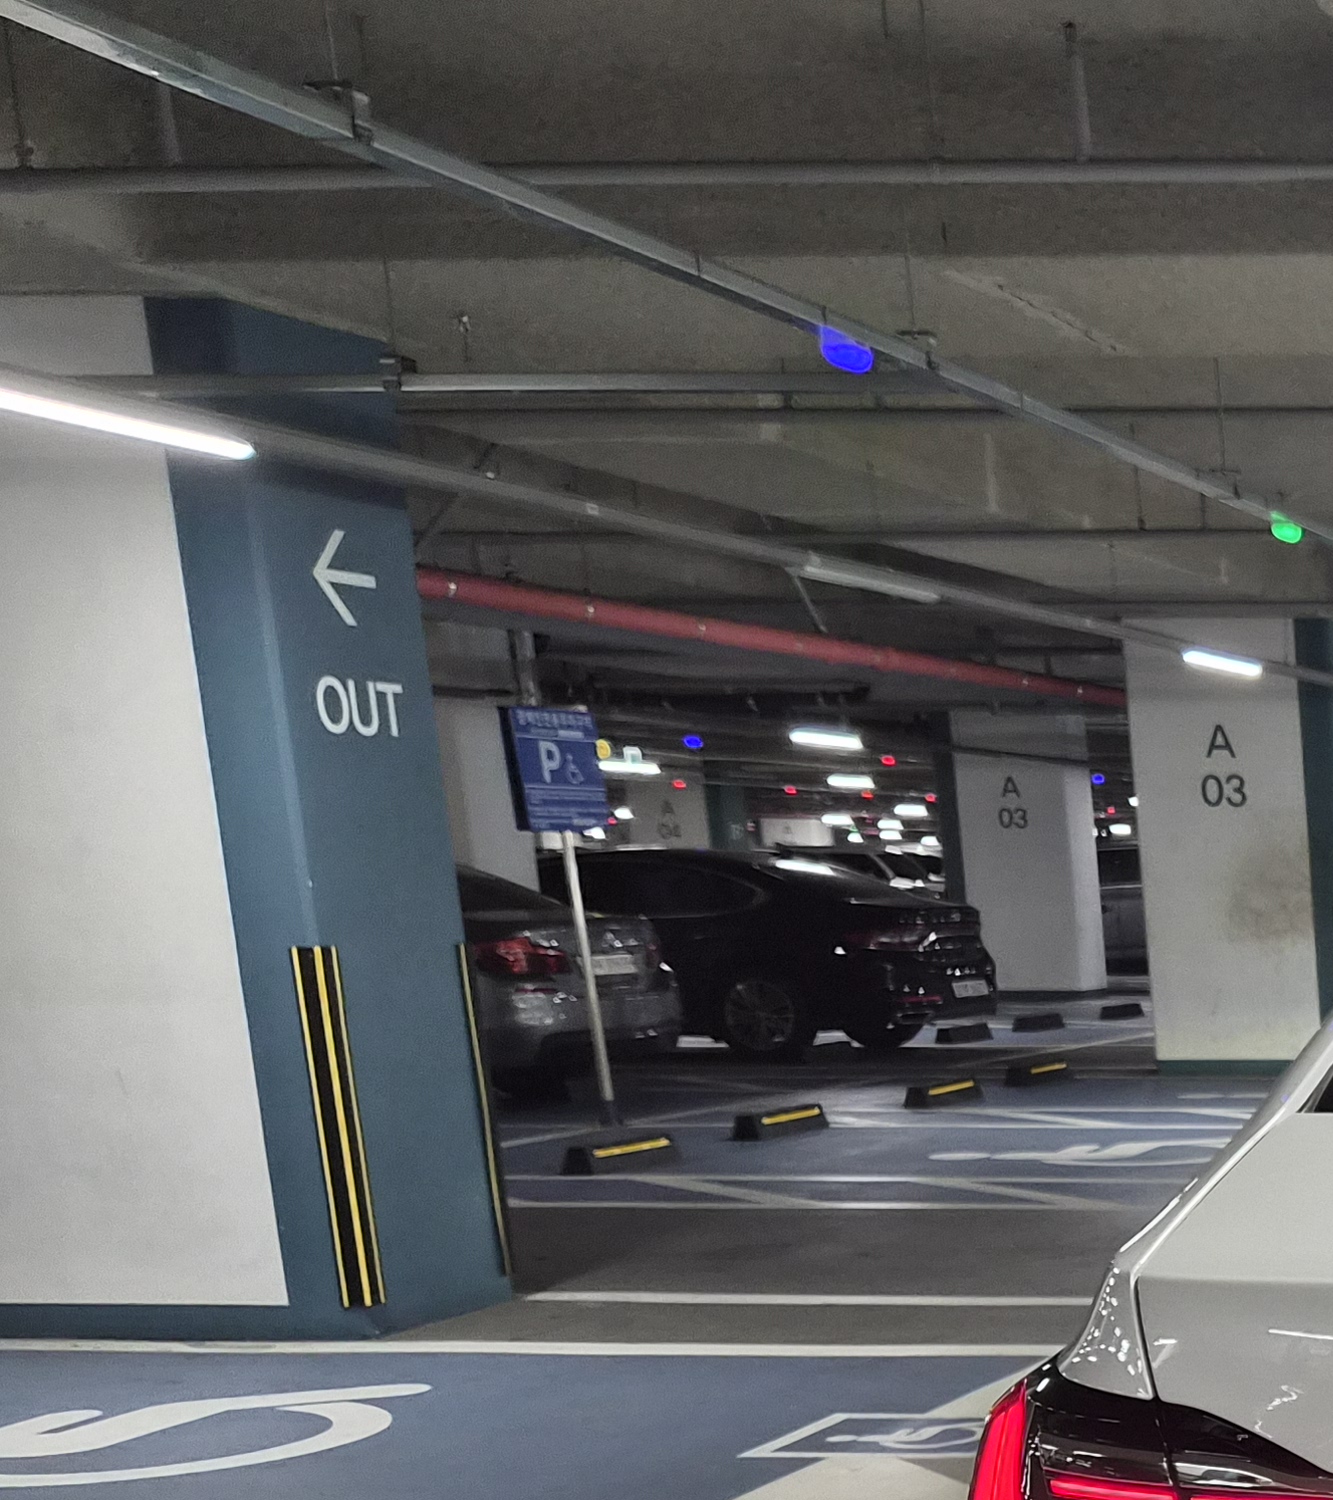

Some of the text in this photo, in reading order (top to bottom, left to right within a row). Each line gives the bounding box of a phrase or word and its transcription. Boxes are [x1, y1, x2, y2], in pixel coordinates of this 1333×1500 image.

[316, 675, 404, 737] OUT
[1206, 724, 1237, 758] A
[538, 740, 561, 783] P
[1002, 776, 1020, 798] A
[1201, 774, 1247, 807] 03
[999, 808, 1028, 829] 03
